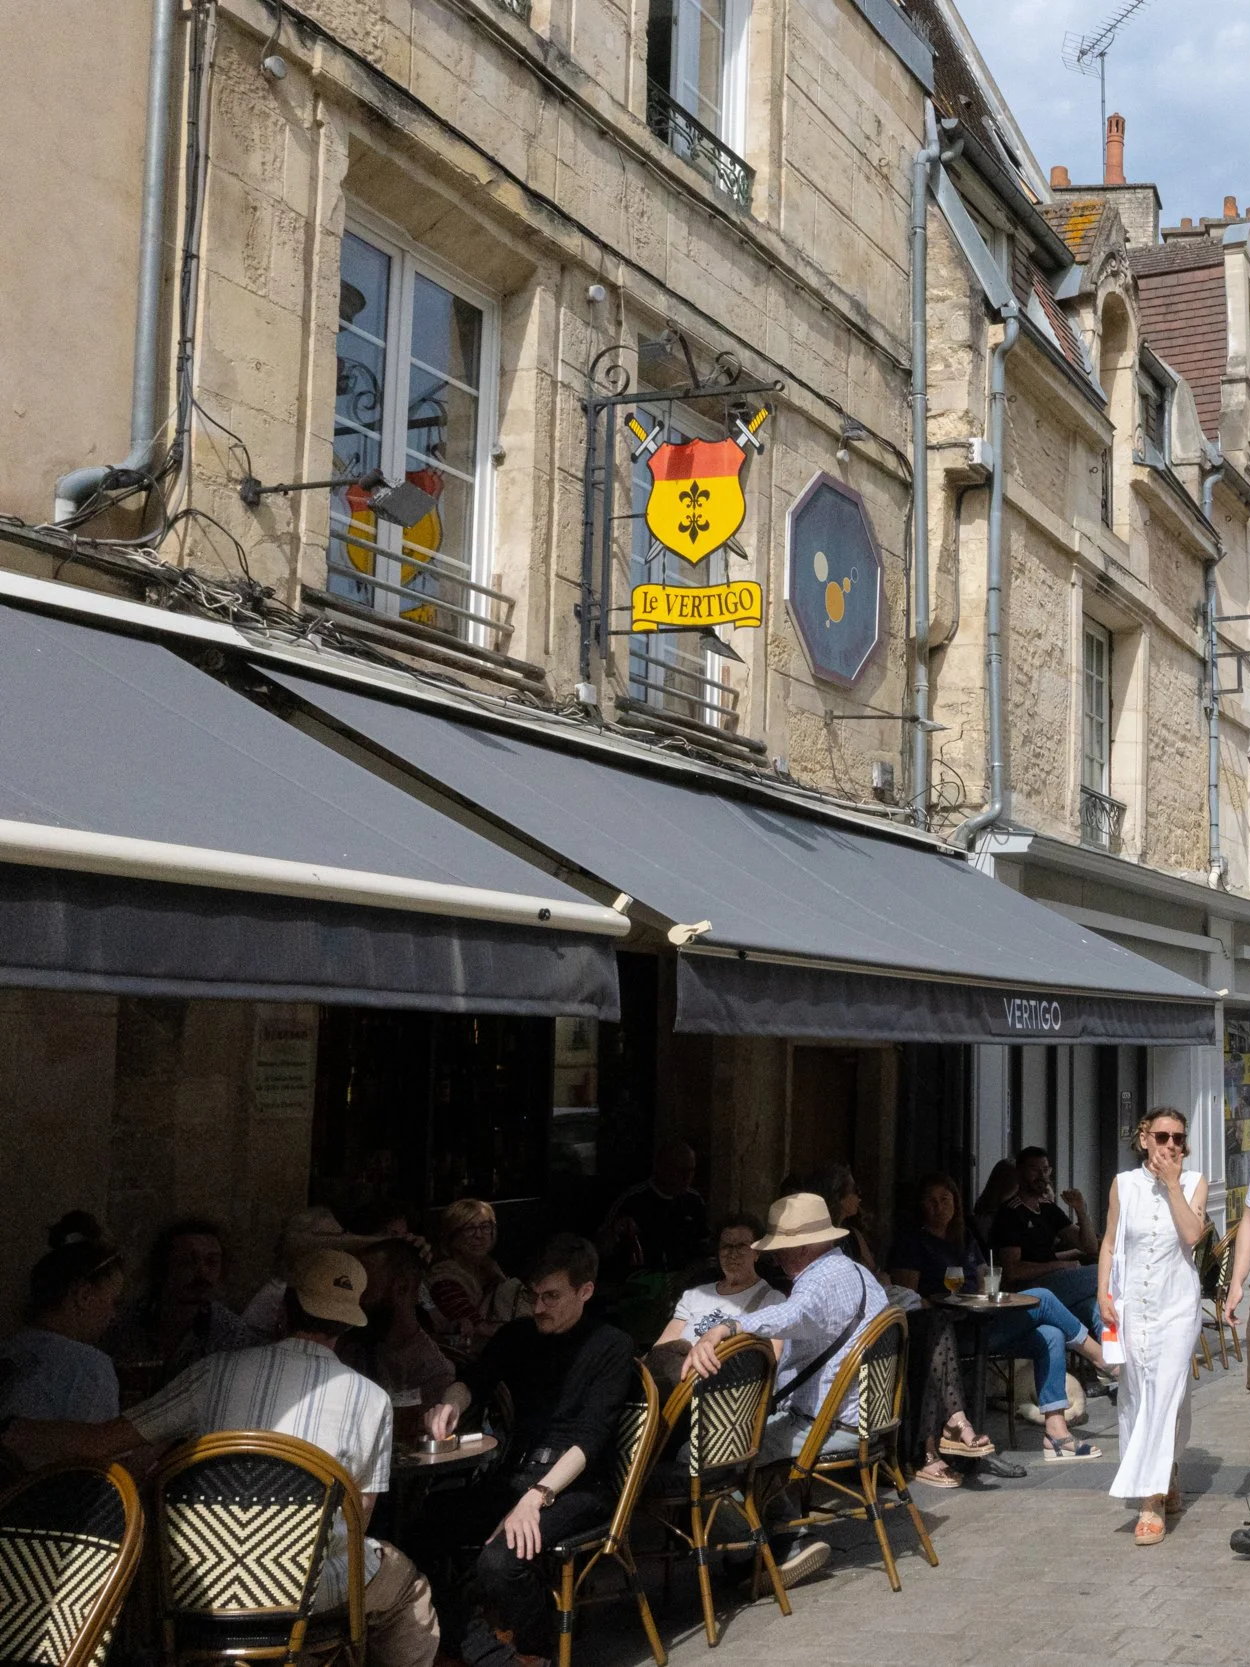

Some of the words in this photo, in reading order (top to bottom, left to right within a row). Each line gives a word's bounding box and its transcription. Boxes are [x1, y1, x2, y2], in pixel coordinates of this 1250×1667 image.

[641, 591, 658, 614] Le
[665, 588, 754, 618] VERTIGO
[1003, 997, 1062, 1030] VERTIGO
